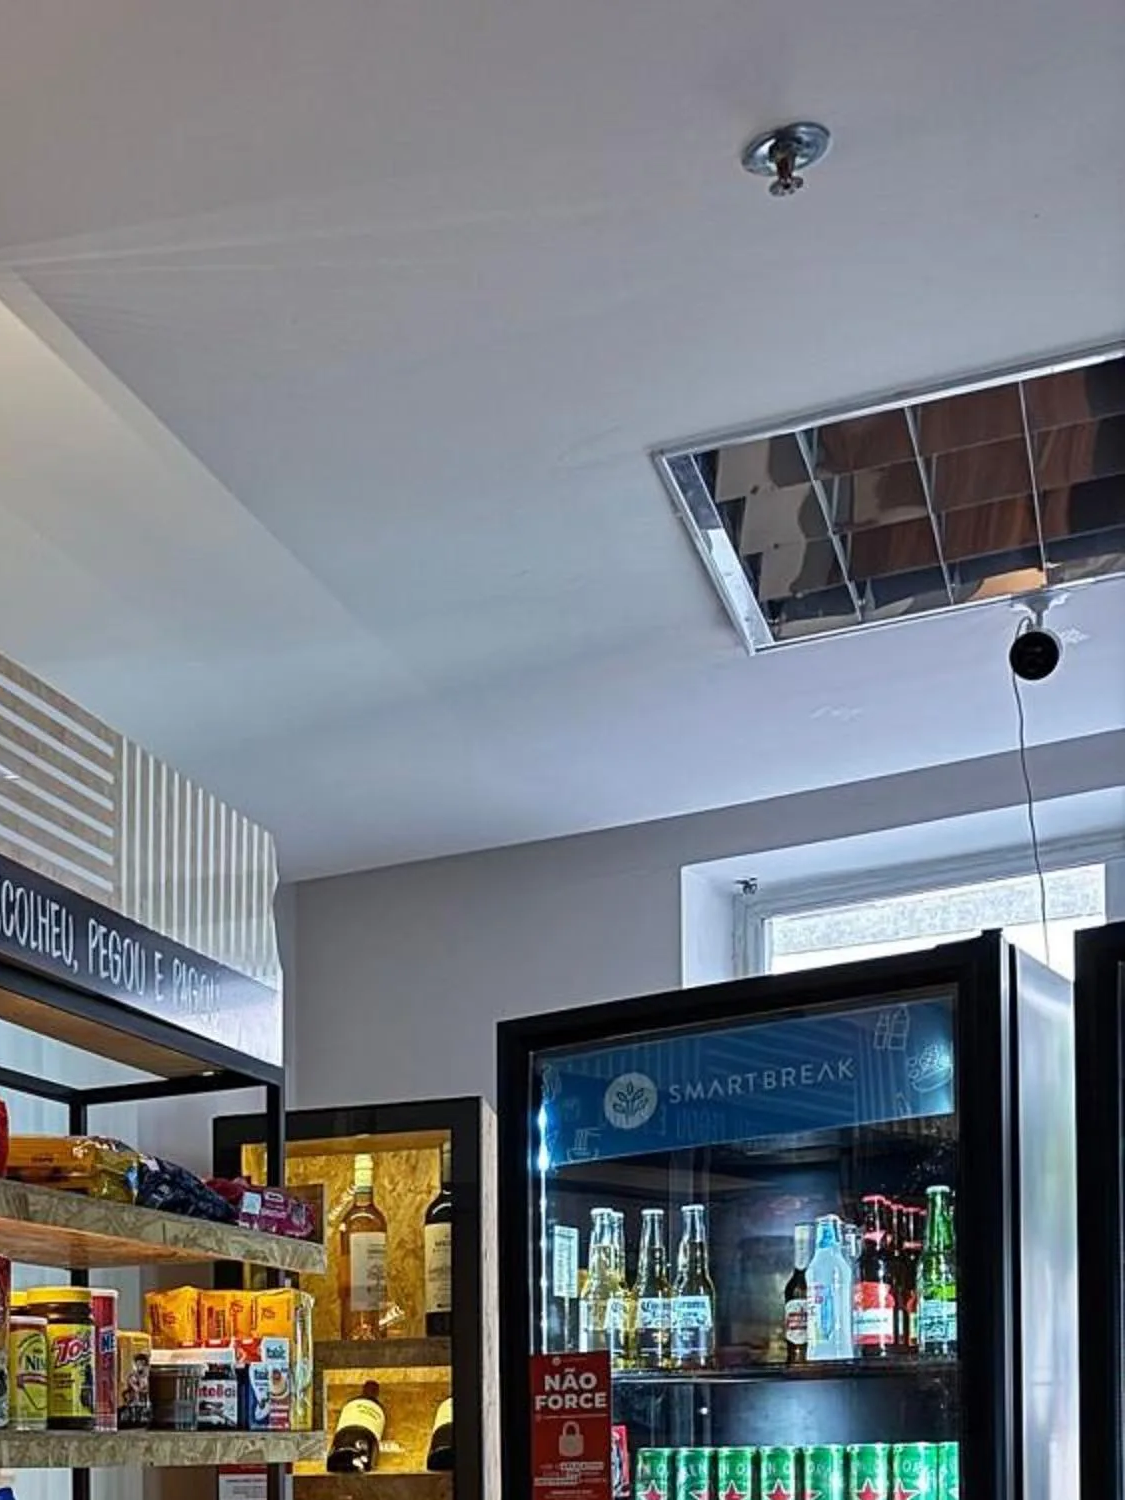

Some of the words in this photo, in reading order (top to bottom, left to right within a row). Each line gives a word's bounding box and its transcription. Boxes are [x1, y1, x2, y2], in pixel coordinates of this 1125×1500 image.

[88, 917, 147, 997] PEGOU
[154, 951, 164, 1001] E
[668, 1056, 857, 1106] SMARTBREAK
[543, 1367, 598, 1392] NÃO
[534, 1391, 608, 1411] FORCE
